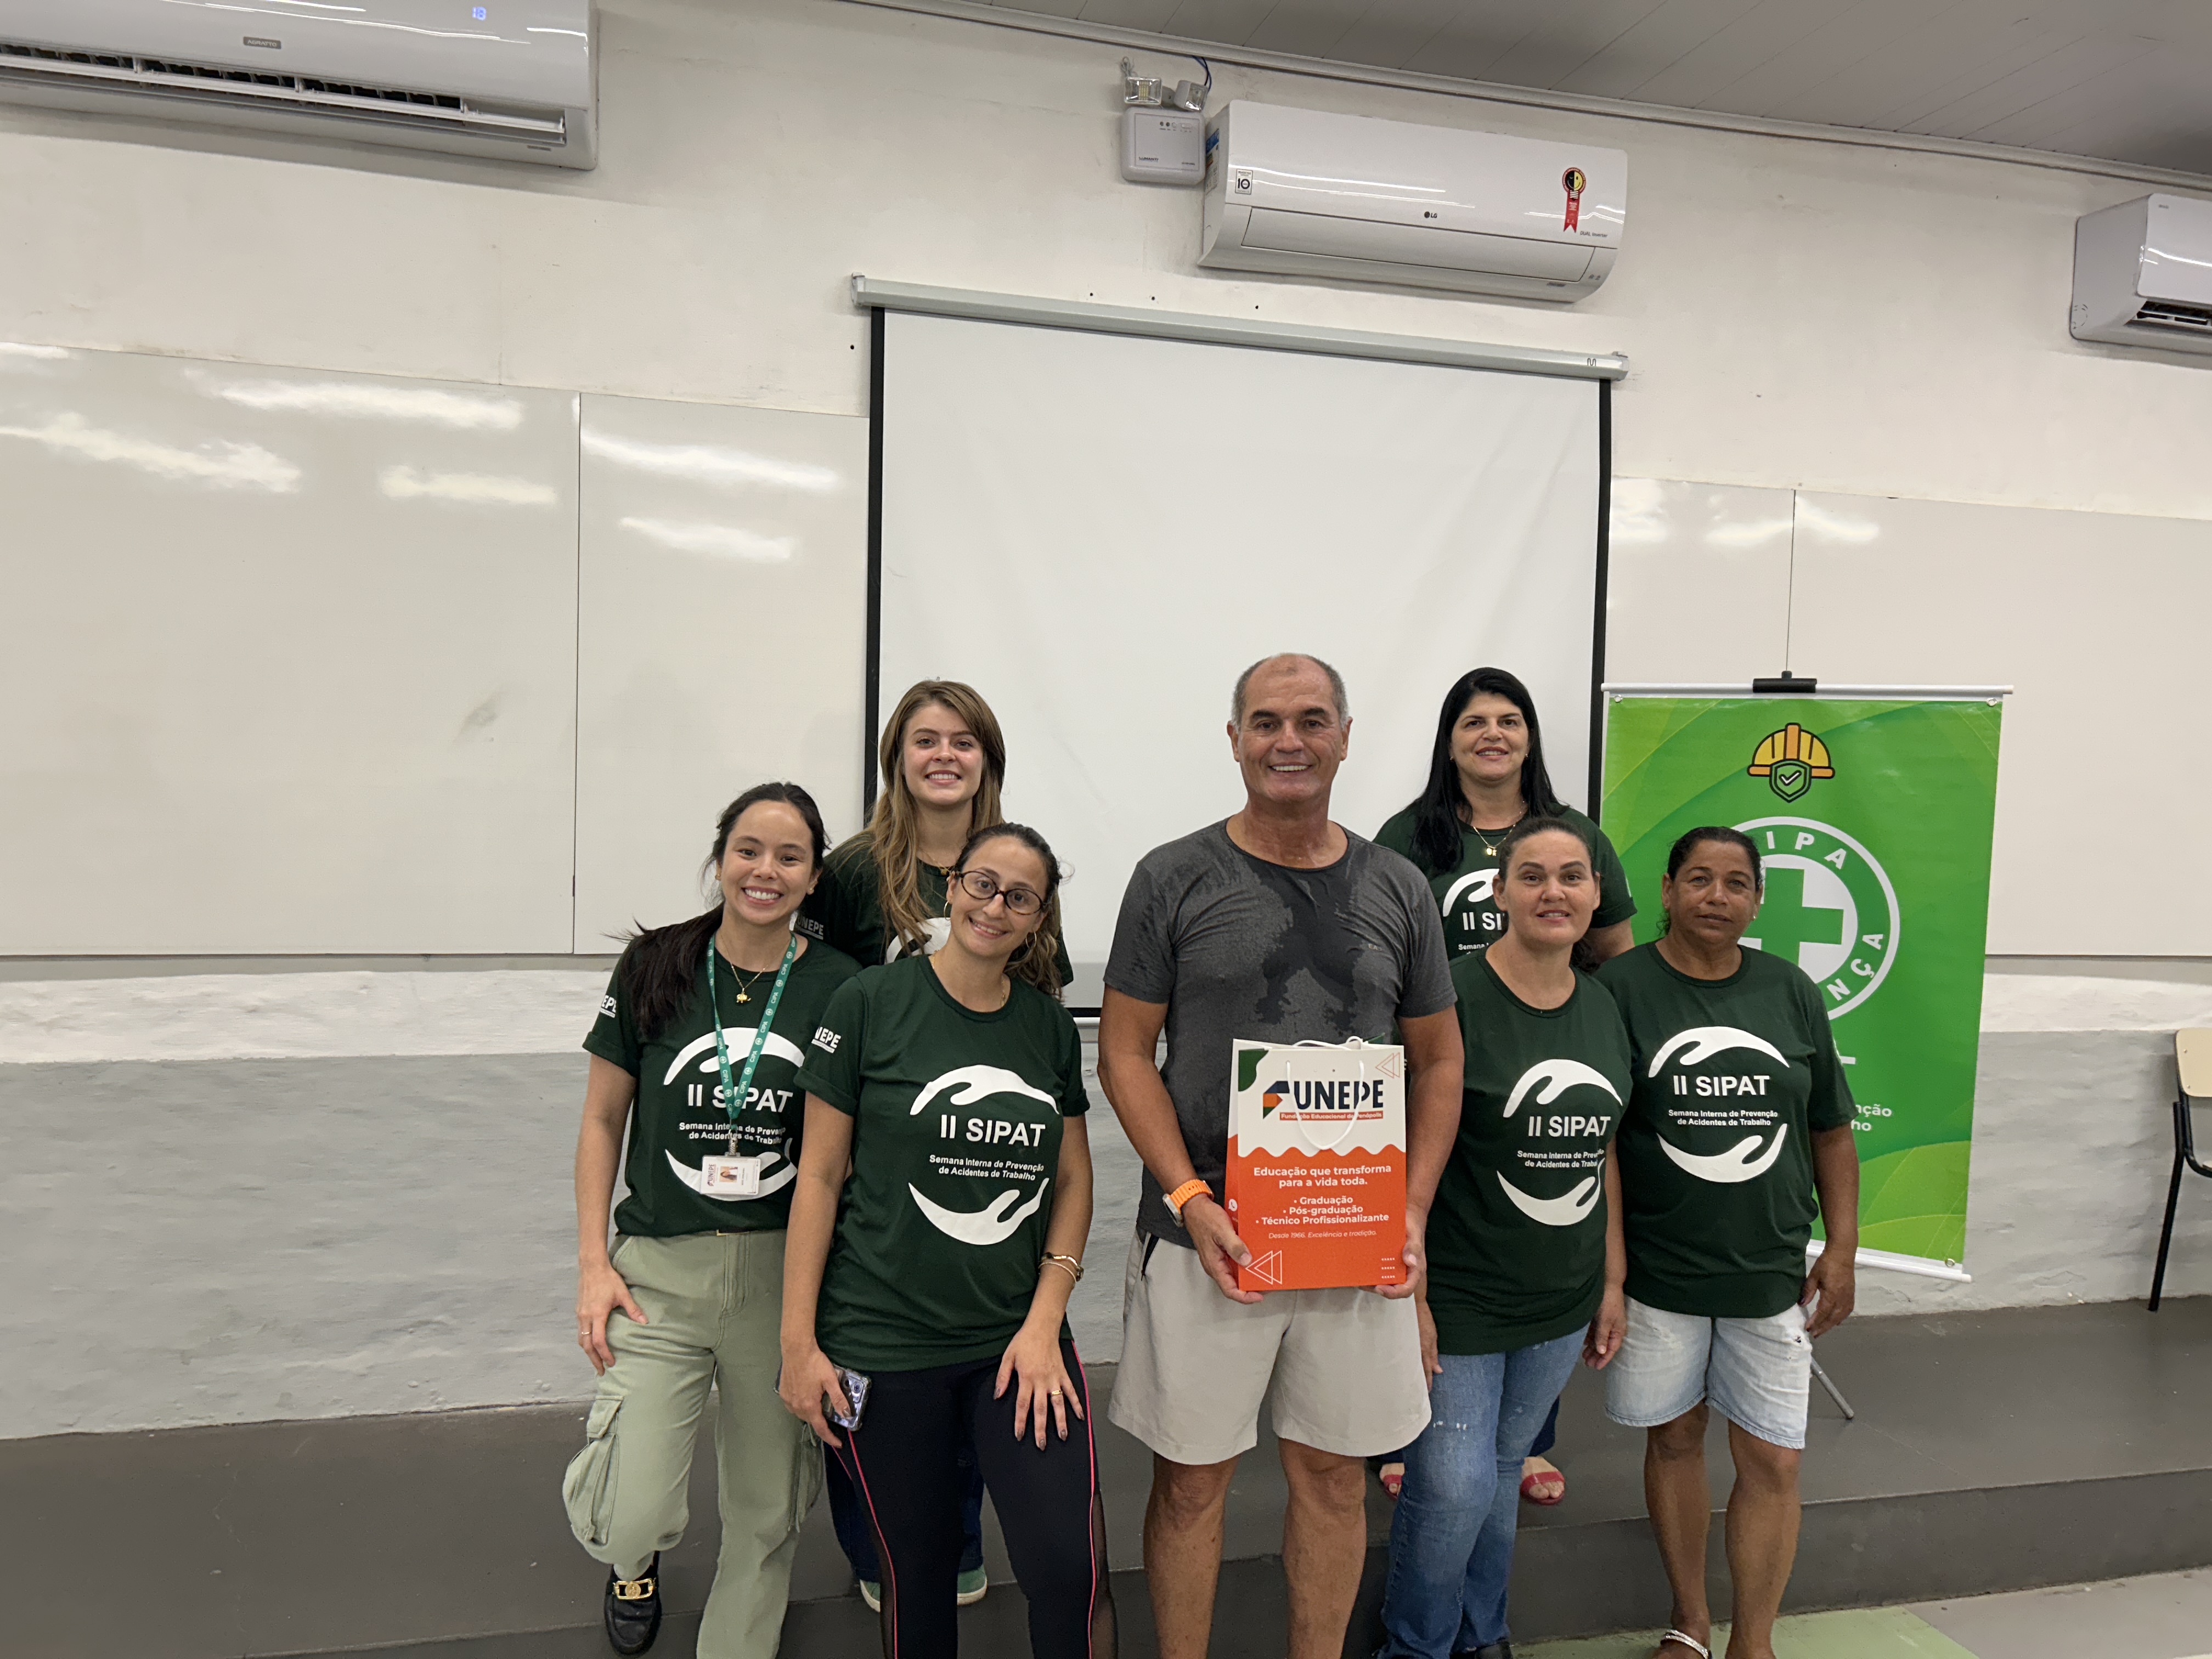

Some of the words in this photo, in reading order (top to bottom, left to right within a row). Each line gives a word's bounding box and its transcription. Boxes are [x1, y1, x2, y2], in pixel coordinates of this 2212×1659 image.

[1238, 178, 1250, 190] 10
[1766, 831, 1847, 870] IPA
[798, 915, 824, 936] UNEPE
[1462, 912, 1475, 930] II
[771, 992, 779, 1004] CIPA
[815, 1026, 842, 1048] NEPE
[749, 1050, 758, 1063] CIPA
[1673, 1075, 1688, 1095] II
[1696, 1075, 1770, 1097] SIPAT
[688, 1084, 703, 1107] II
[1740, 1109, 1778, 1119] Prevenção
[1855, 1103, 1892, 1118] nção
[679, 1122, 713, 1131] Semana
[745, 1125, 755, 1133] de
[940, 1114, 956, 1139] II
[966, 1118, 1046, 1147] SIPAT
[1528, 1116, 1542, 1137] II
[1548, 1115, 1611, 1137] SIPAT
[1850, 1119, 1871, 1131] ho
[689, 1131, 699, 1139] de
[701, 1132, 742, 1140] Acidentes
[1517, 1150, 1547, 1159] Semana
[929, 1154, 964, 1165] Semana
[965, 1157, 992, 1168] Interna
[994, 1160, 1003, 1168] de
[1006, 1160, 1045, 1172] Prevenção
[939, 1166, 949, 1174] de
[950, 1167, 989, 1177] Acidentes
[990, 1170, 1000, 1178] de
[1002, 1170, 1036, 1181] Trabalho
[1254, 1167, 1307, 1178] Educação
[1310, 1168, 1331, 1177] que
[1334, 1165, 1392, 1175] transforma
[1279, 1180, 1303, 1189] para
[1315, 1177, 1338, 1186] vida
[1341, 1176, 1368, 1186] toda.
[1300, 1195, 1353, 1205] Graduação
[1289, 1205, 1363, 1216] Pós-graduação
[1261, 1216, 1300, 1224] Técnico
[1302, 1214, 1390, 1224] Profissionalizante
